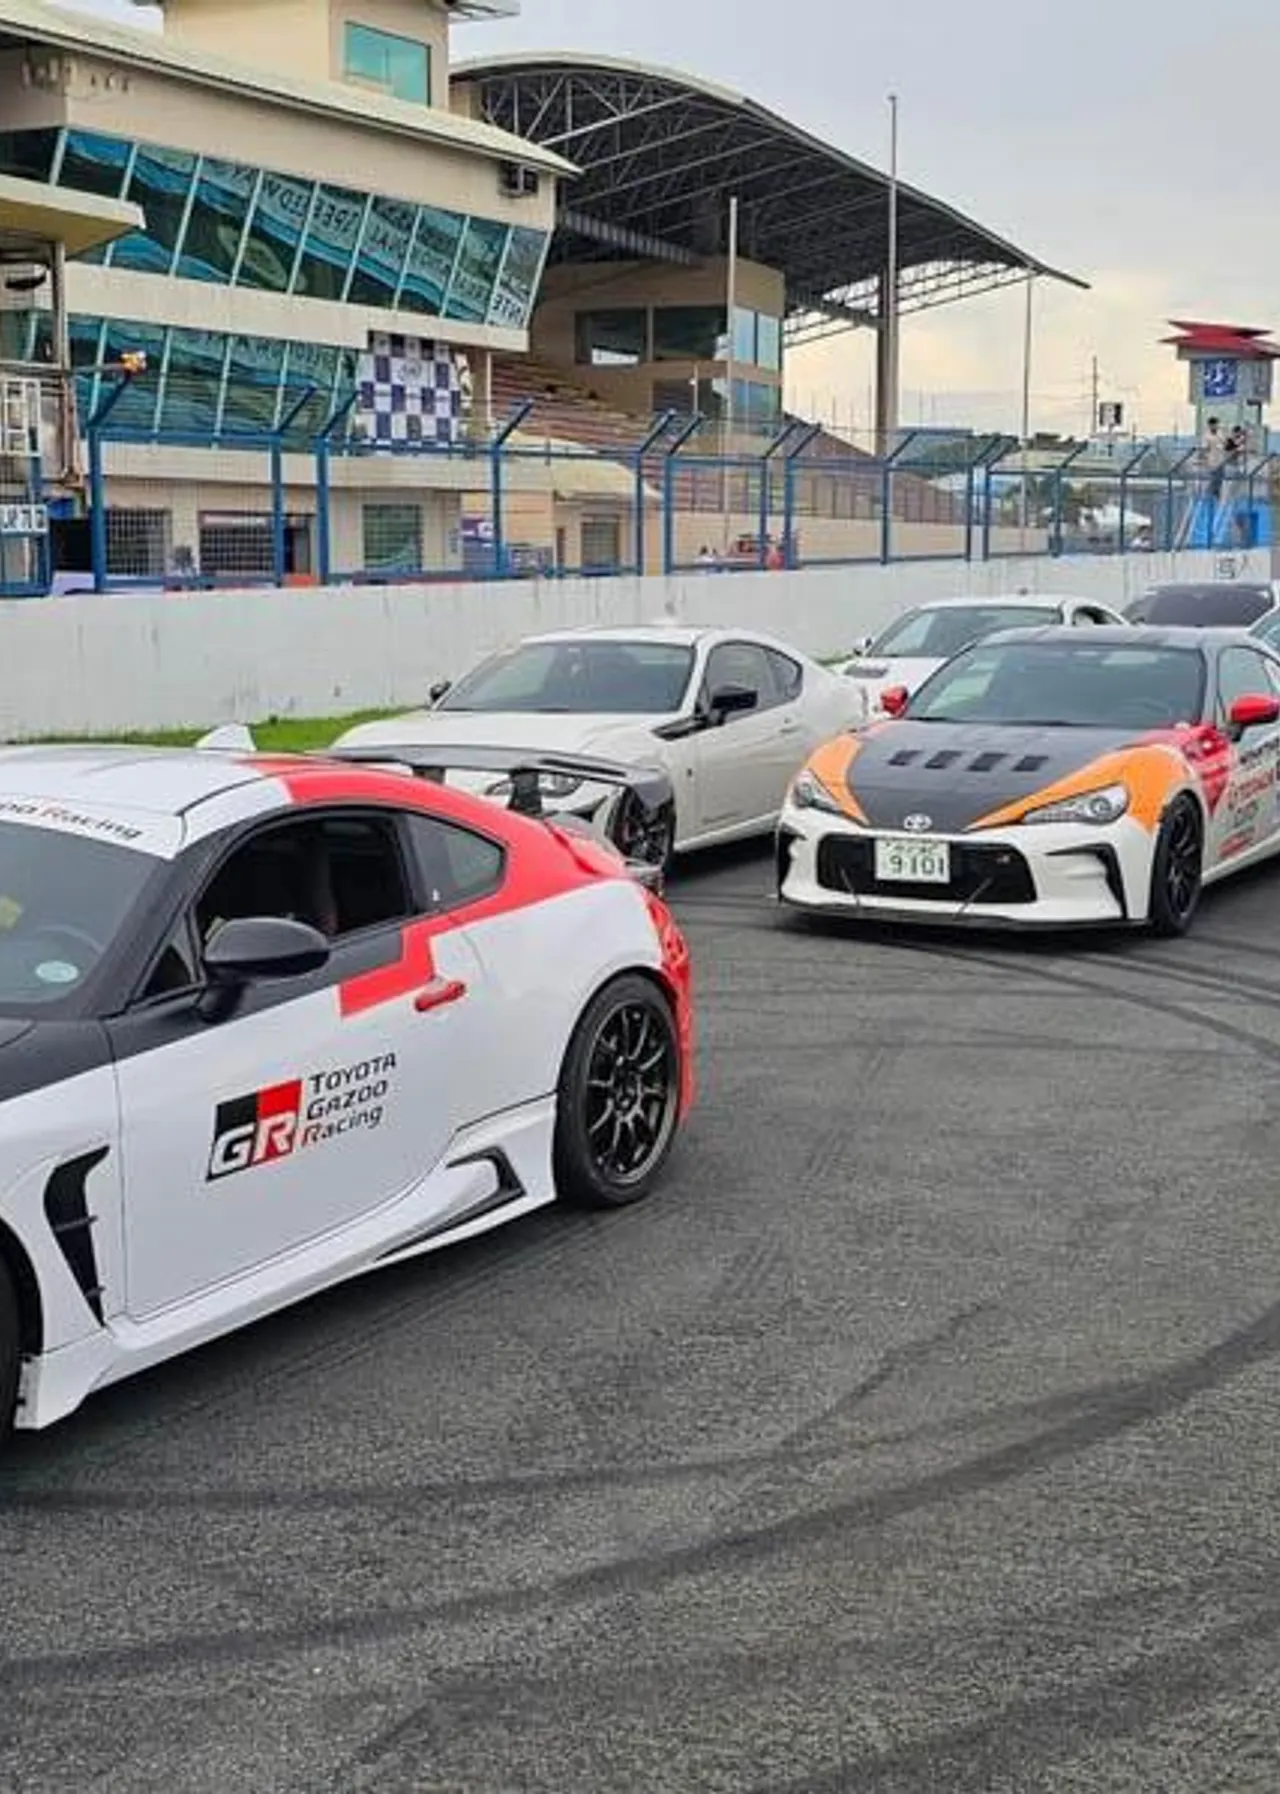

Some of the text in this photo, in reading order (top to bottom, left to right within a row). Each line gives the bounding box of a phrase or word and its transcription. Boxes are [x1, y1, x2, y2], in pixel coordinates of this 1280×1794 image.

[39, 805, 143, 840] Racing
[309, 1051, 397, 1095] TOYOTA
[306, 1079, 389, 1121] GAZOO
[209, 1109, 297, 1175] GR
[300, 1105, 384, 1148] Racing
